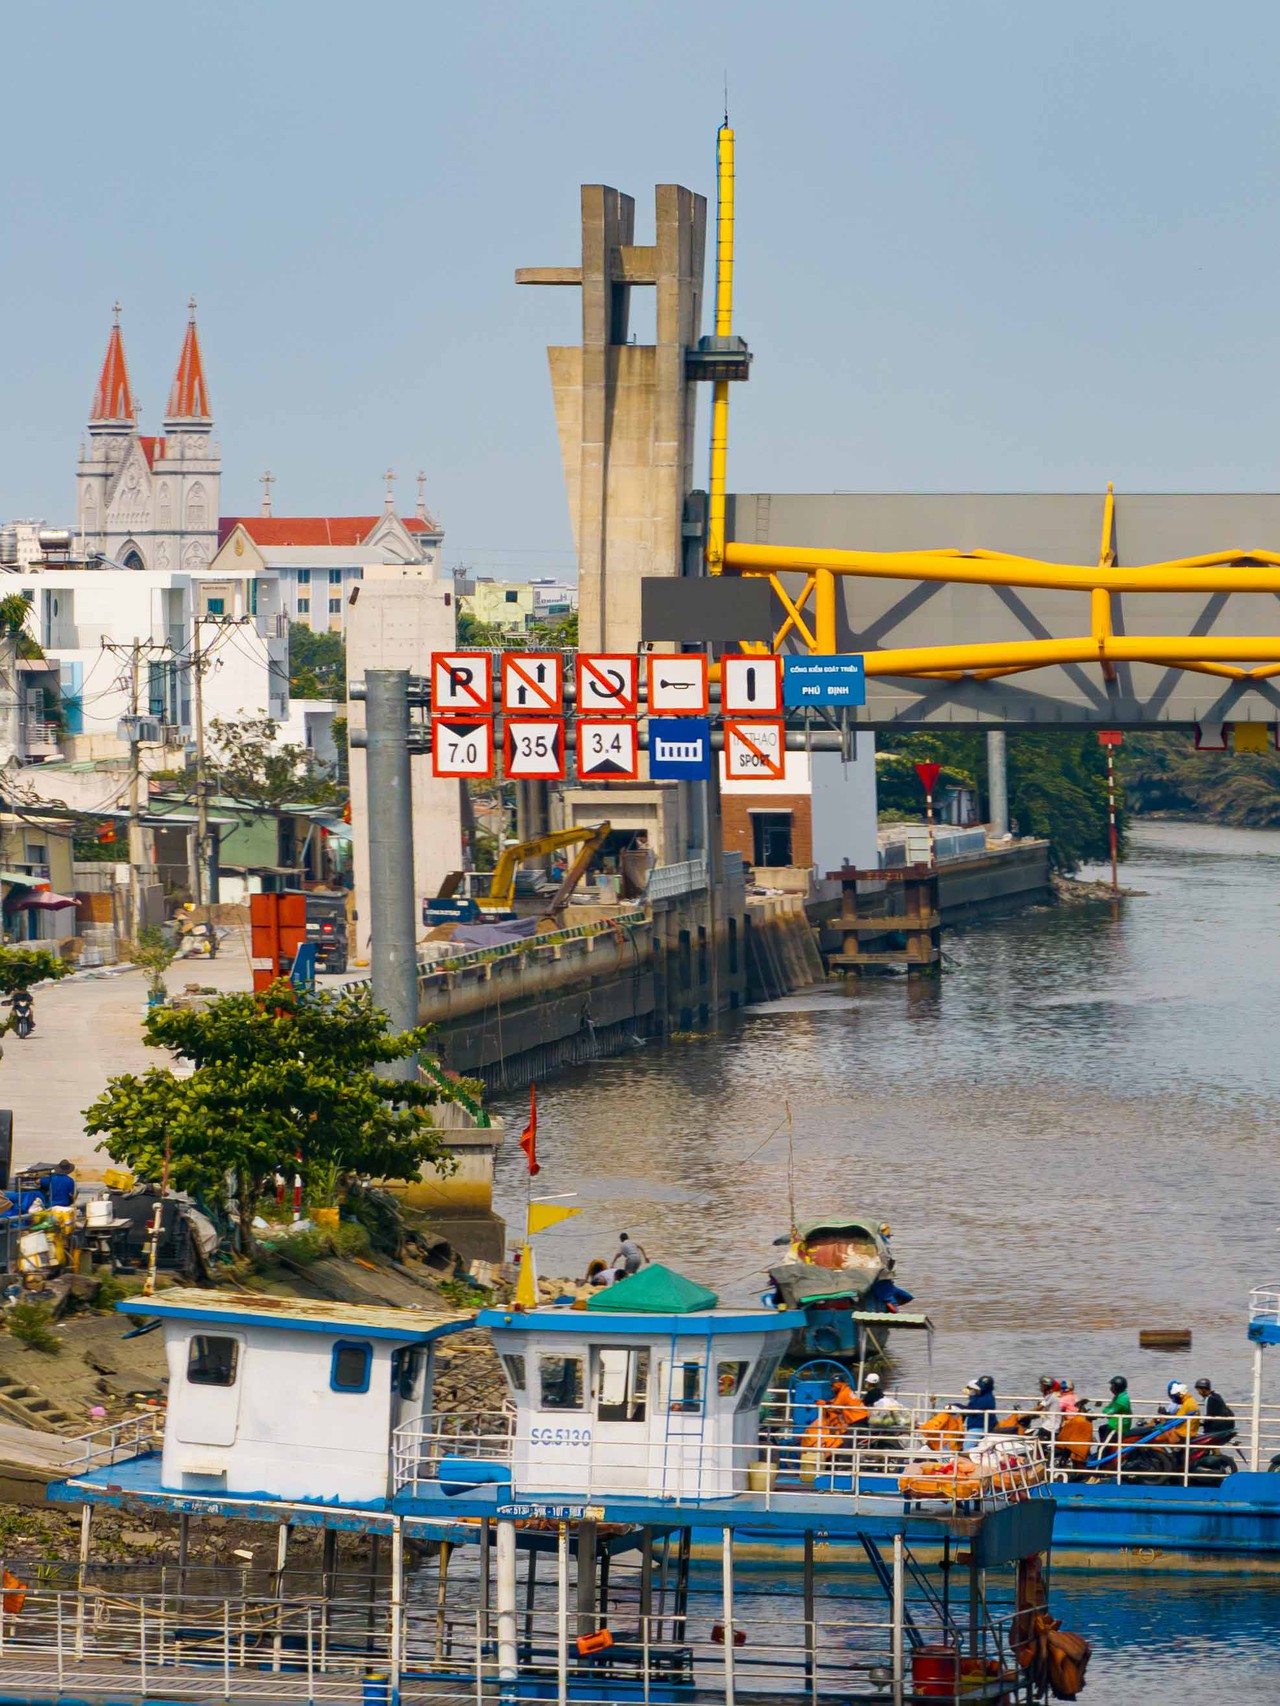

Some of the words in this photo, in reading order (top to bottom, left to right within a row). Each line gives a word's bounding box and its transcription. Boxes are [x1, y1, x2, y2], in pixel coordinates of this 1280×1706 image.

[450, 667, 473, 697] P
[447, 743, 477, 764] 7.0
[521, 735, 548, 758] 35
[592, 733, 622, 753] 3.4
